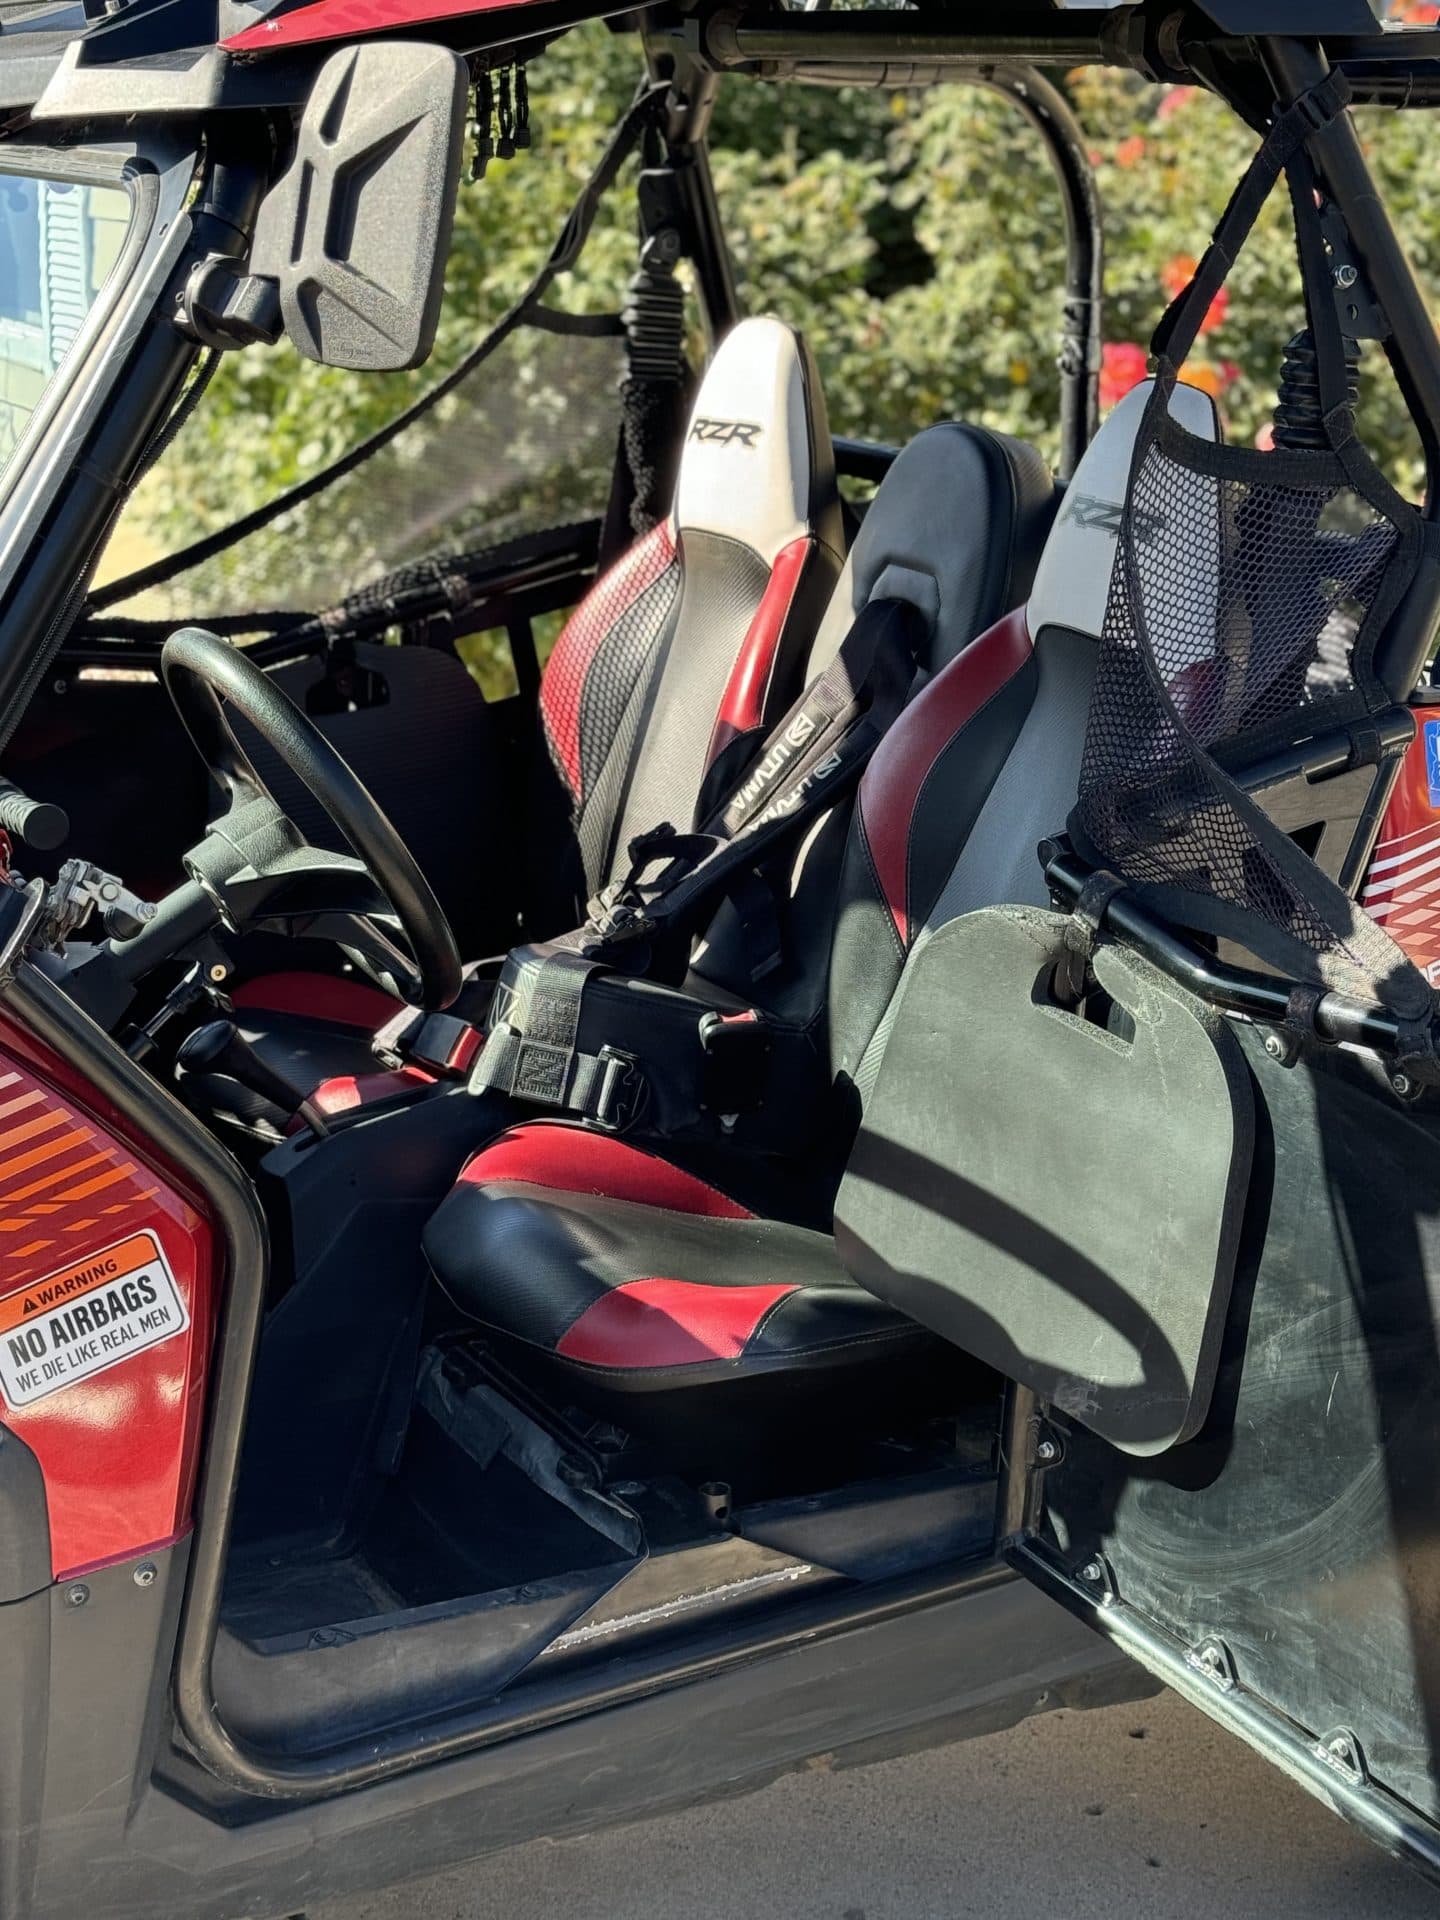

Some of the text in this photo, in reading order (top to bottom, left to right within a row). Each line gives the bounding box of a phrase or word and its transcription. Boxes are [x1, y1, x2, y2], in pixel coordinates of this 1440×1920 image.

[688, 418, 762, 447] RZR
[731, 745, 790, 809] UTVMA
[37, 1258, 118, 1305] WARNING
[7, 1275, 157, 1368] NO AIRBAGS
[16, 1305, 171, 1393] WE DIE LIKE REAL MEN
